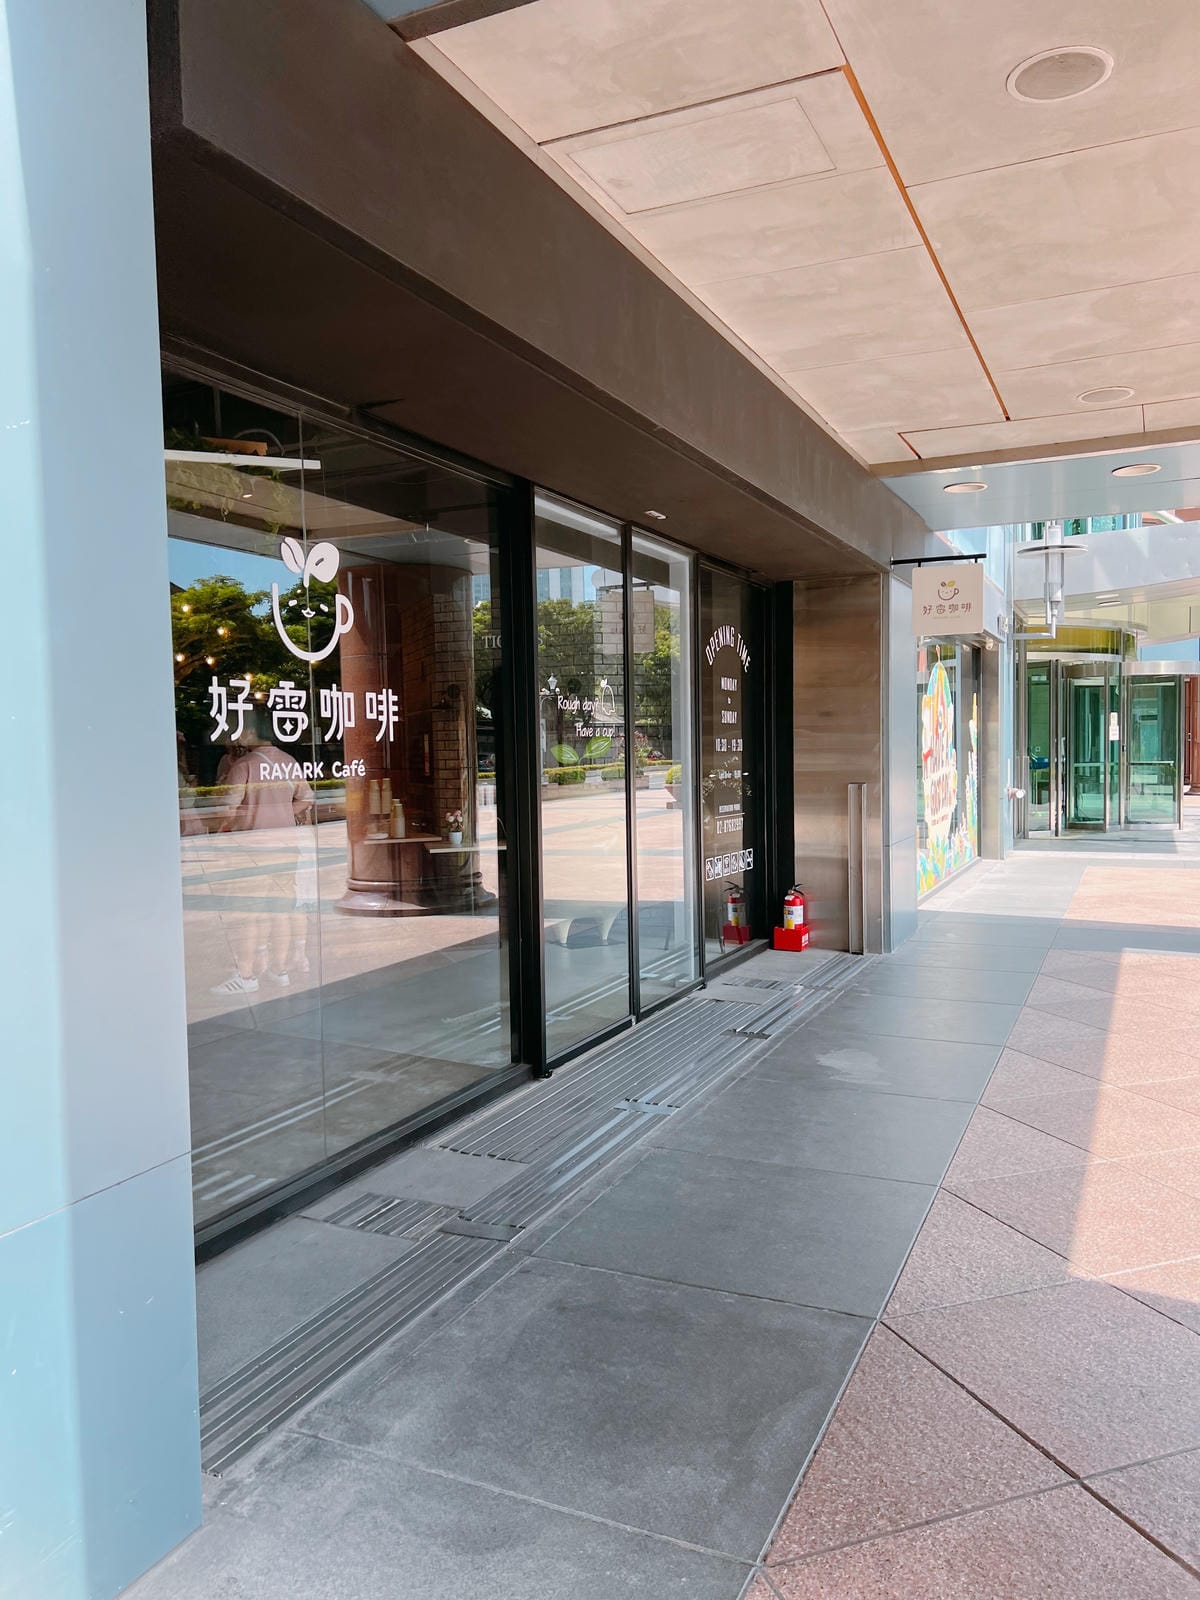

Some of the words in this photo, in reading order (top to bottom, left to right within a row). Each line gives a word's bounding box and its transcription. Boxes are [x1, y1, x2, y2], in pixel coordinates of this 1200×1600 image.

[705, 625, 735, 666] OPENING
[736, 633, 751, 673] TIME
[721, 676, 737, 691] MONDAY
[558, 695, 580, 714] Rough
[583, 696, 599, 715] day?
[721, 710, 737, 724] SUNDAY
[576, 724, 593, 737] Have
[596, 728, 600, 737] a
[259, 761, 324, 781] RAYARK
[331, 759, 366, 777] Café
